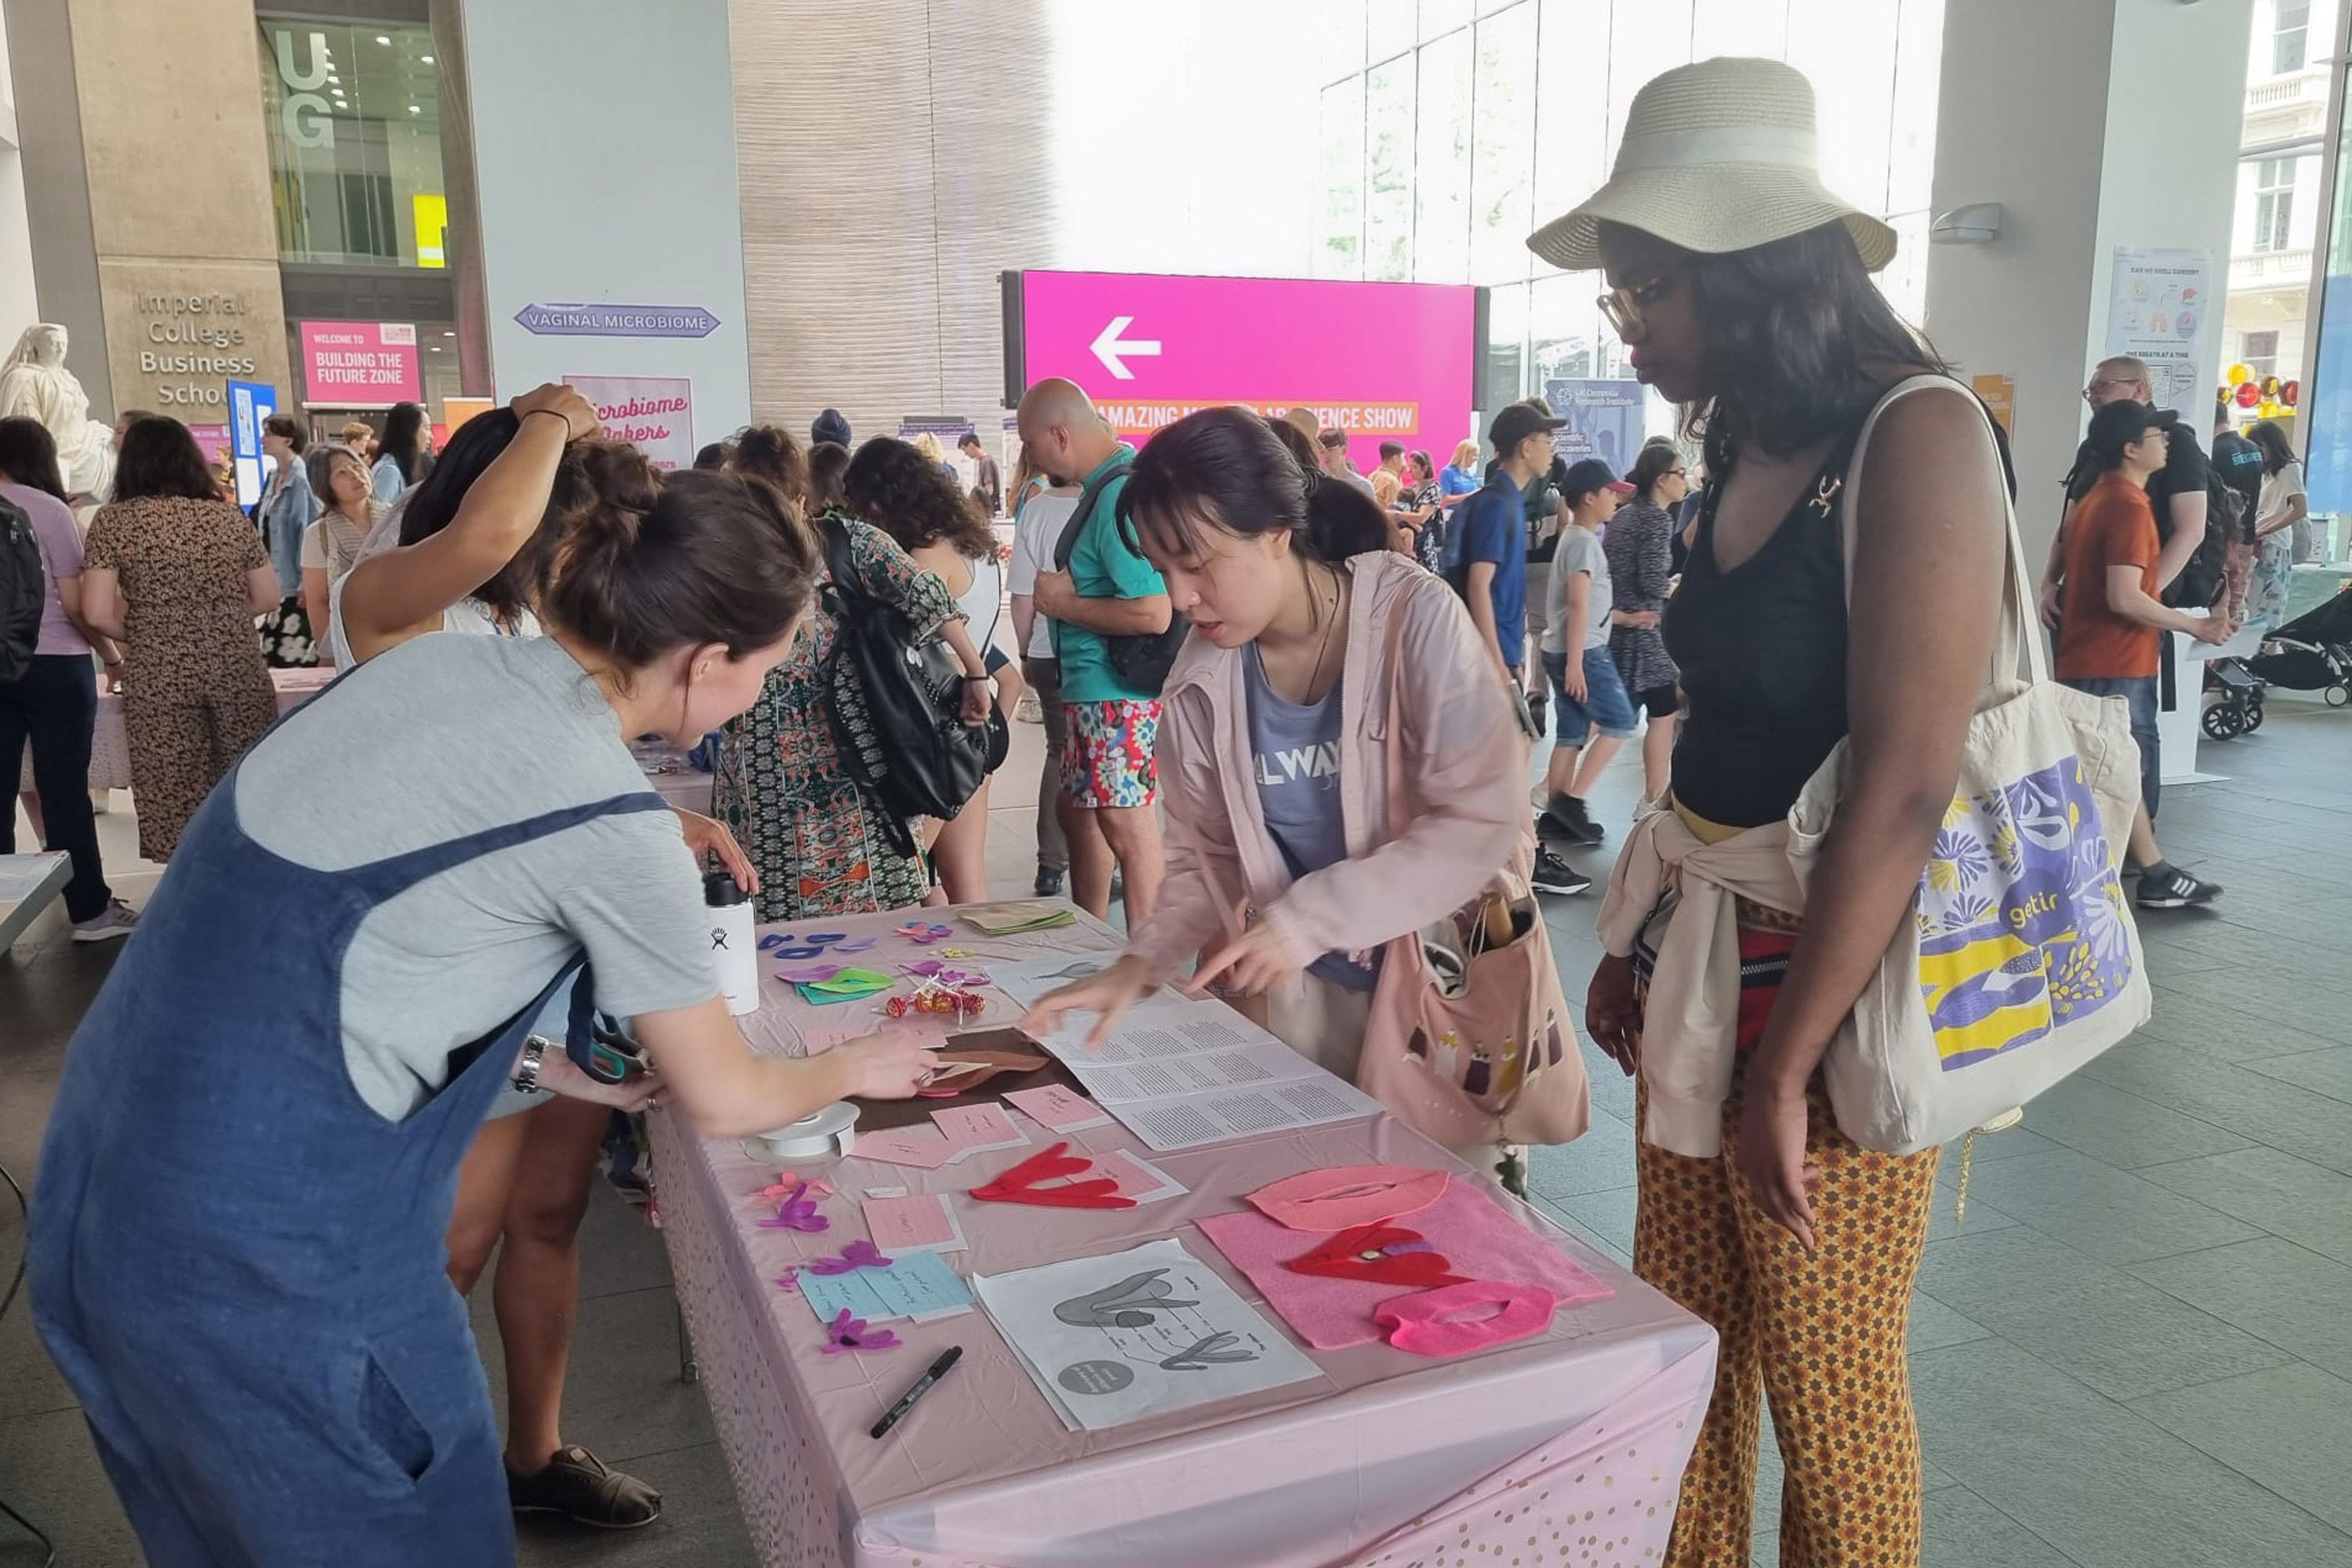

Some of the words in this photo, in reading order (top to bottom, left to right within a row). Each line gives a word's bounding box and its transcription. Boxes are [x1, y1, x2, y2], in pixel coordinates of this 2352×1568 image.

[137, 292, 246, 319] Imperial
[528, 313, 601, 327] VAGINAL
[604, 314, 707, 329] MICROBIOME
[148, 321, 245, 350] College
[314, 334, 351, 344] WELCOME
[354, 335, 364, 344] TO
[140, 351, 256, 374] Business
[316, 352, 375, 368] BUILDING
[378, 354, 402, 368] THE
[317, 368, 368, 384] FUTURE
[369, 369, 403, 384] ZONE
[159, 382, 227, 405] Scho
[593, 397, 688, 421] crobiome
[1363, 407, 1412, 429] SHOW
[2009, 891, 2058, 929] getir
